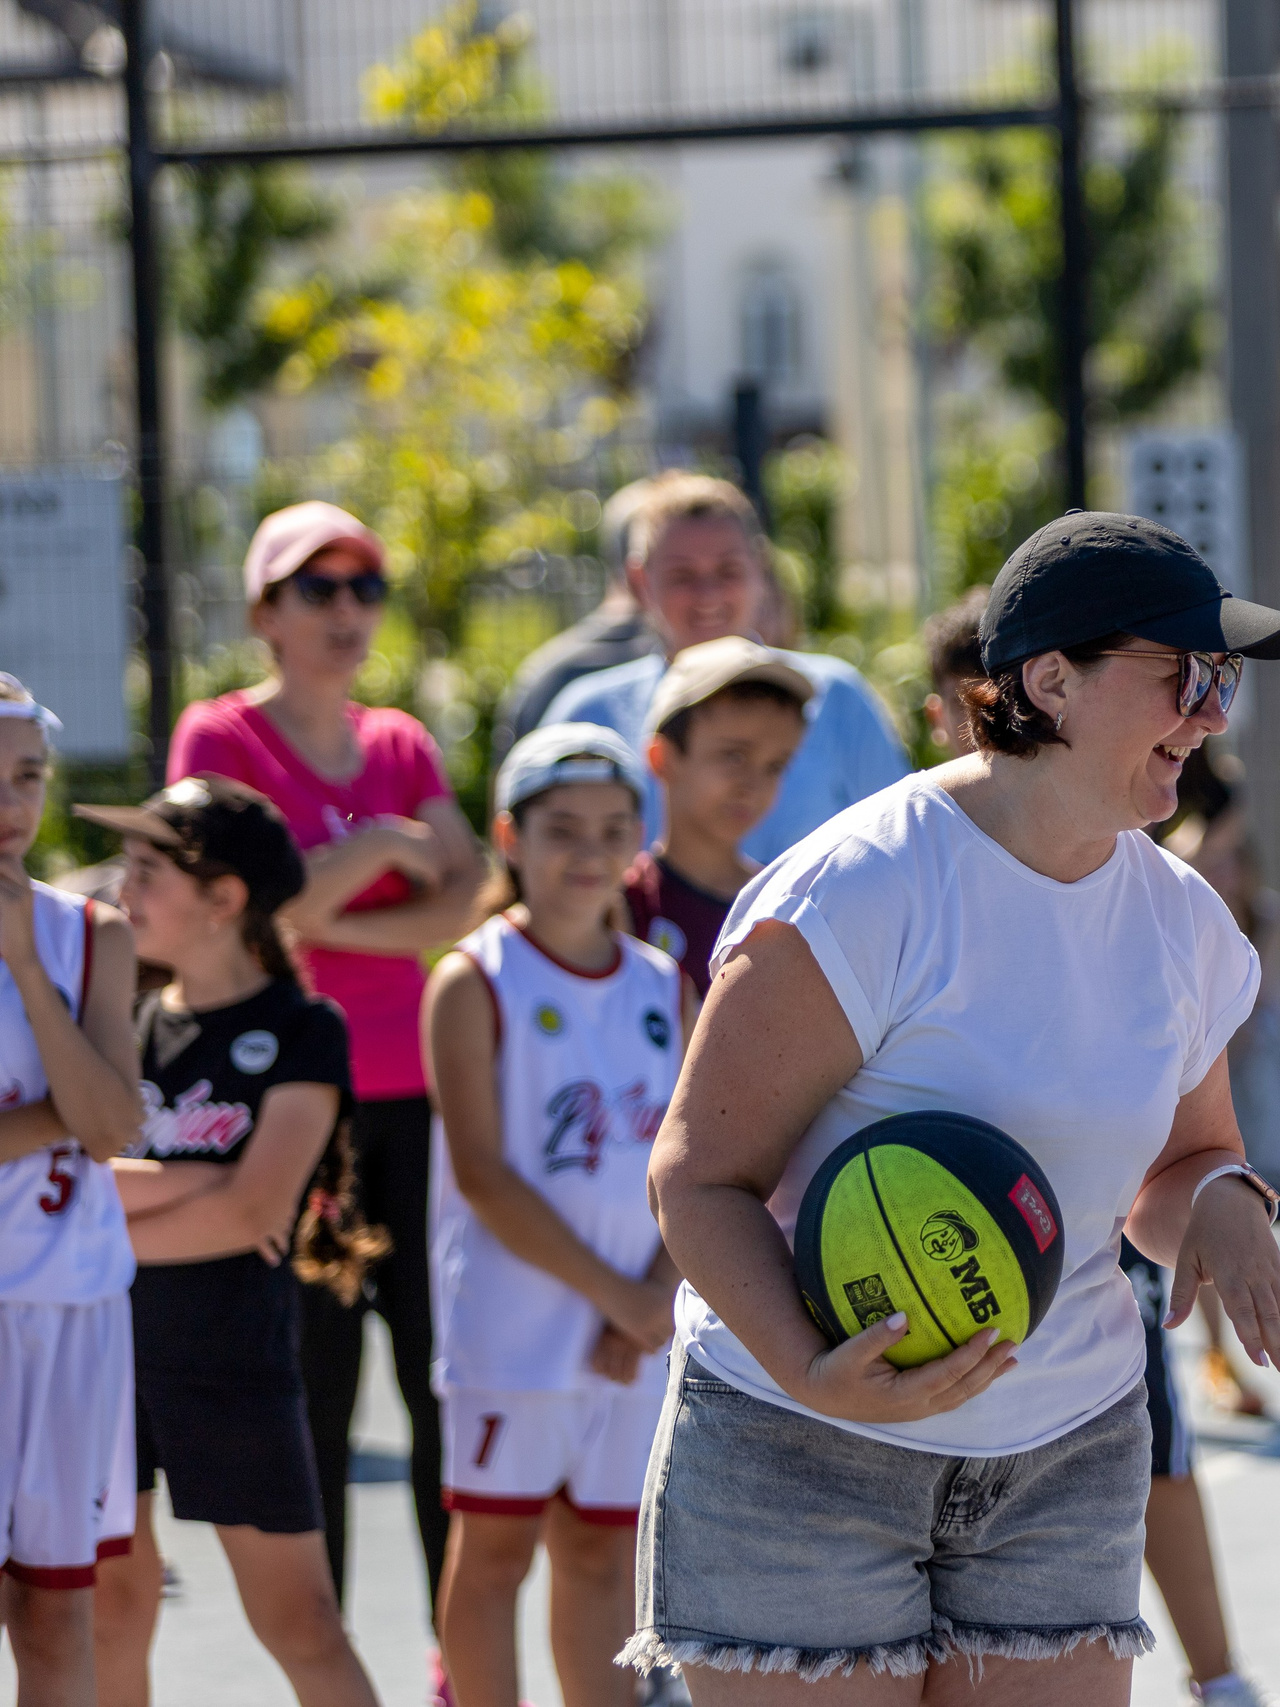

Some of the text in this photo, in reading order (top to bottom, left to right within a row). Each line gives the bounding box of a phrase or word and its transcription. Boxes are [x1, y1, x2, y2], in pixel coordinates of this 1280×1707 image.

[39, 1144, 76, 1216] 5
[852, 1283, 864, 1301] FIBA
[949, 1254, 1002, 1325] МБ
[471, 1412, 506, 1470] 1
